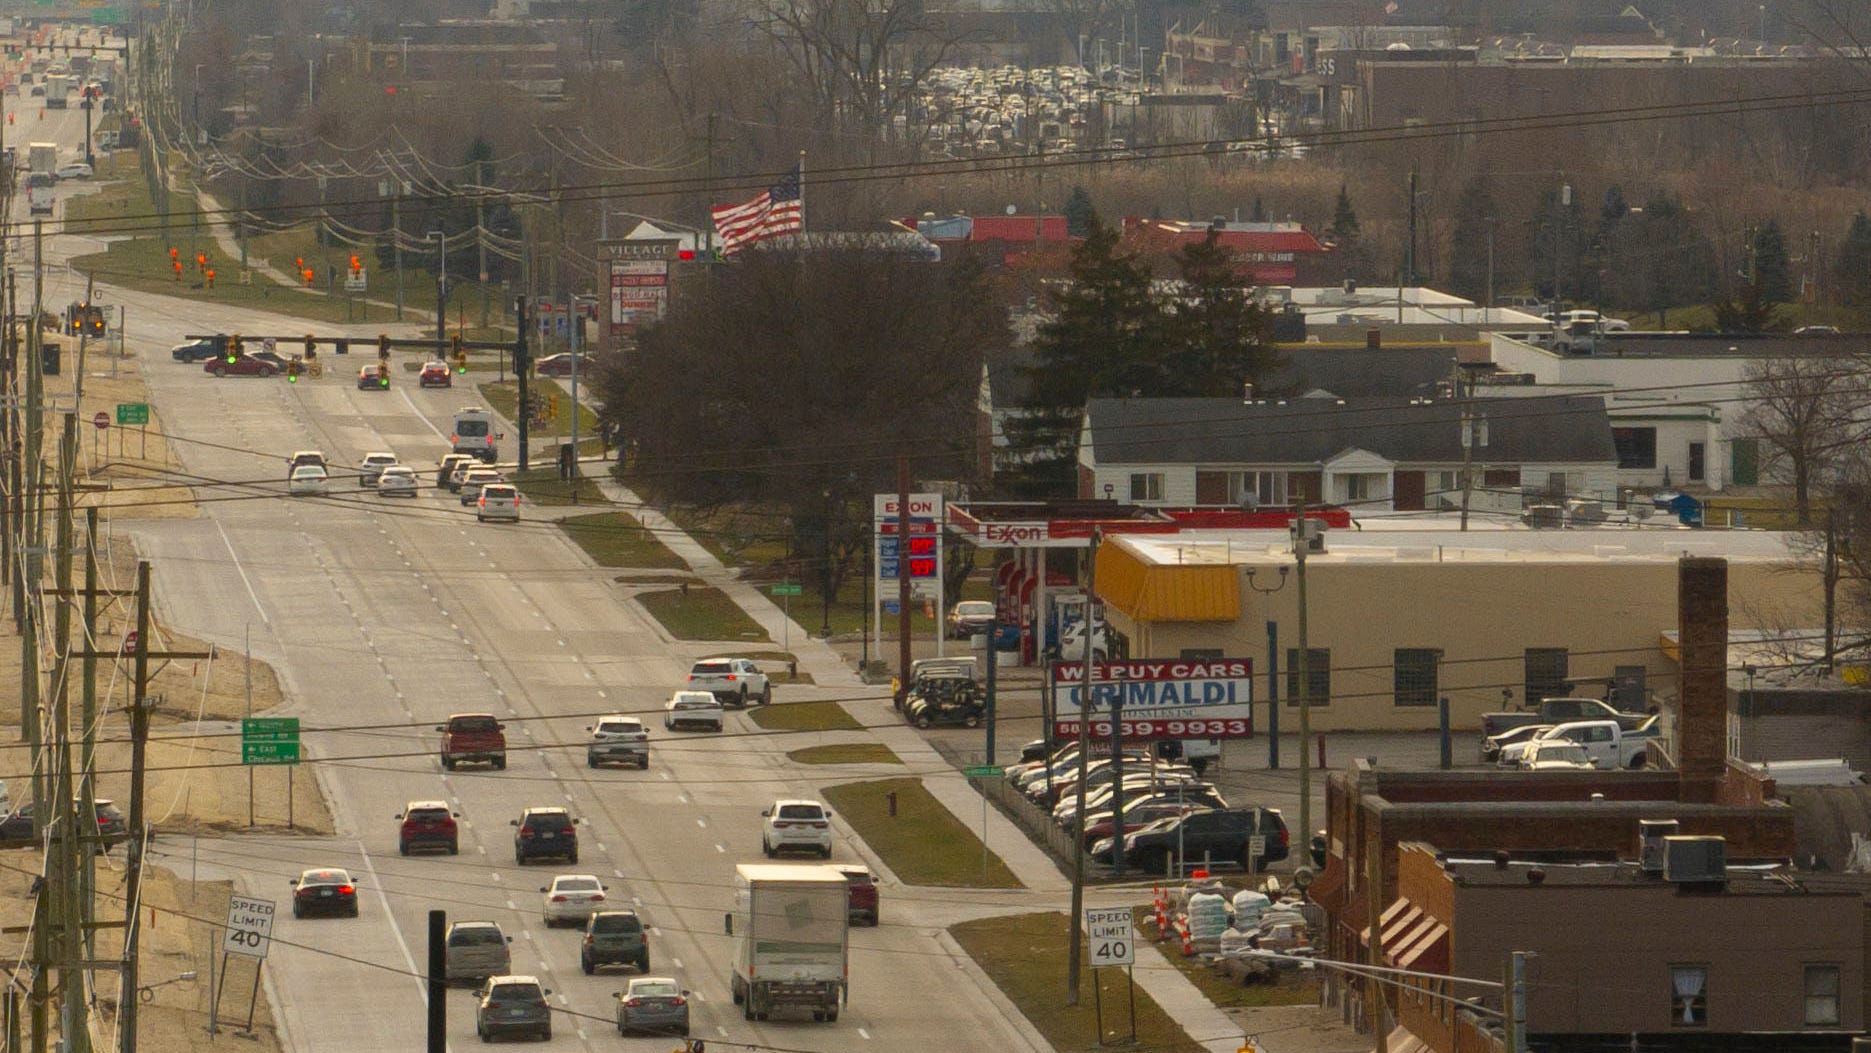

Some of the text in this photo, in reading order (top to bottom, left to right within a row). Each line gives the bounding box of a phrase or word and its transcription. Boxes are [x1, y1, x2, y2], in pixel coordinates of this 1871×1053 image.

[885, 501, 932, 513] EON
[1170, 663, 1246, 678] CARS
[1095, 720, 1246, 737] 939-9933
[231, 900, 274, 915] SPEED
[232, 914, 267, 928] LIMIT
[1089, 911, 1131, 924] SPEED
[230, 930, 260, 948] 40
[1093, 926, 1126, 938] LIMIT
[1096, 941, 1127, 960] 40
